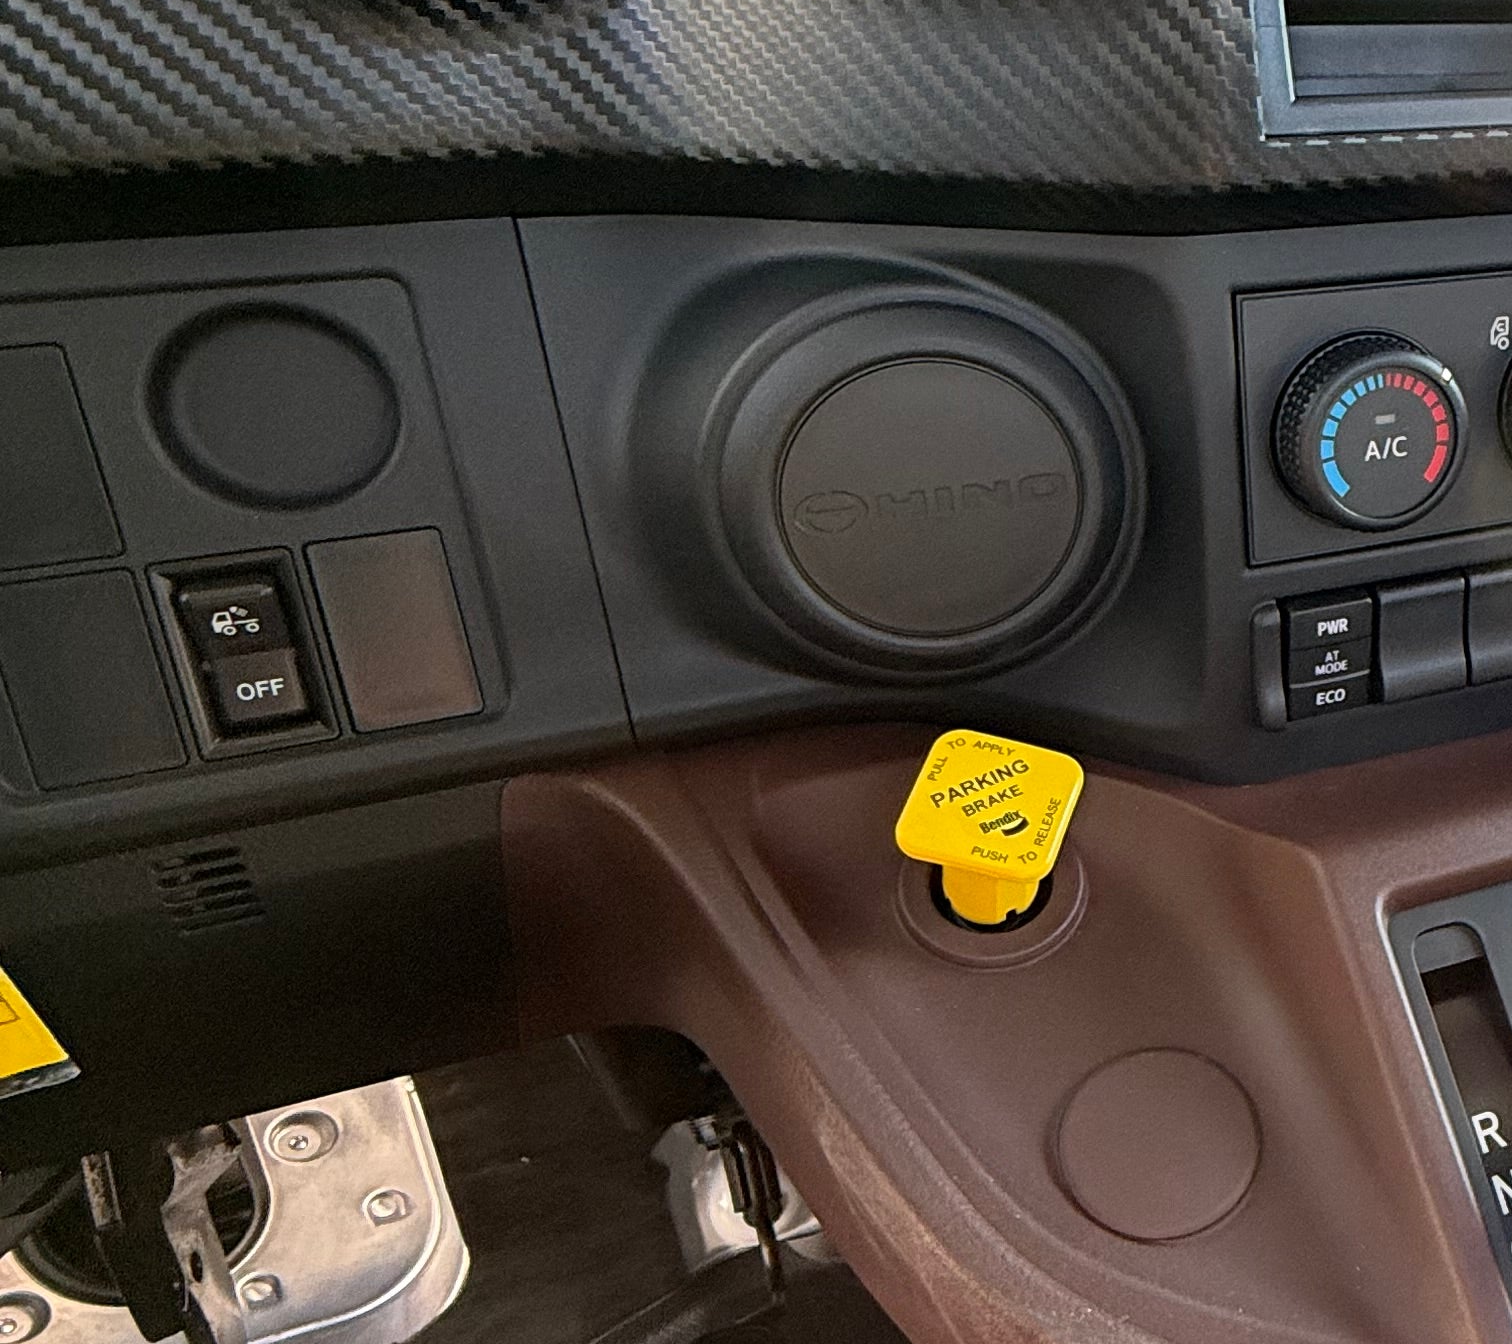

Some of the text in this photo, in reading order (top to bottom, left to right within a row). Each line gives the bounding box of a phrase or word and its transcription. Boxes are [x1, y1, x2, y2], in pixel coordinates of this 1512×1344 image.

[1364, 436, 1409, 462] A/C
[875, 471, 1068, 515] HINO
[1317, 618, 1348, 637] PWR
[1315, 659, 1348, 676] MODE
[1324, 650, 1340, 663] AT
[236, 677, 284, 701] OFF
[1315, 688, 1346, 706] ECO
[927, 737, 1016, 782] PULL TO APPLY
[929, 758, 1030, 809] PARKING
[961, 784, 1024, 817] BRAKE
[970, 797, 1062, 865] PUSH TO RELEASE
[979, 809, 1023, 834] Bendix
[1472, 1111, 1508, 1154] R
